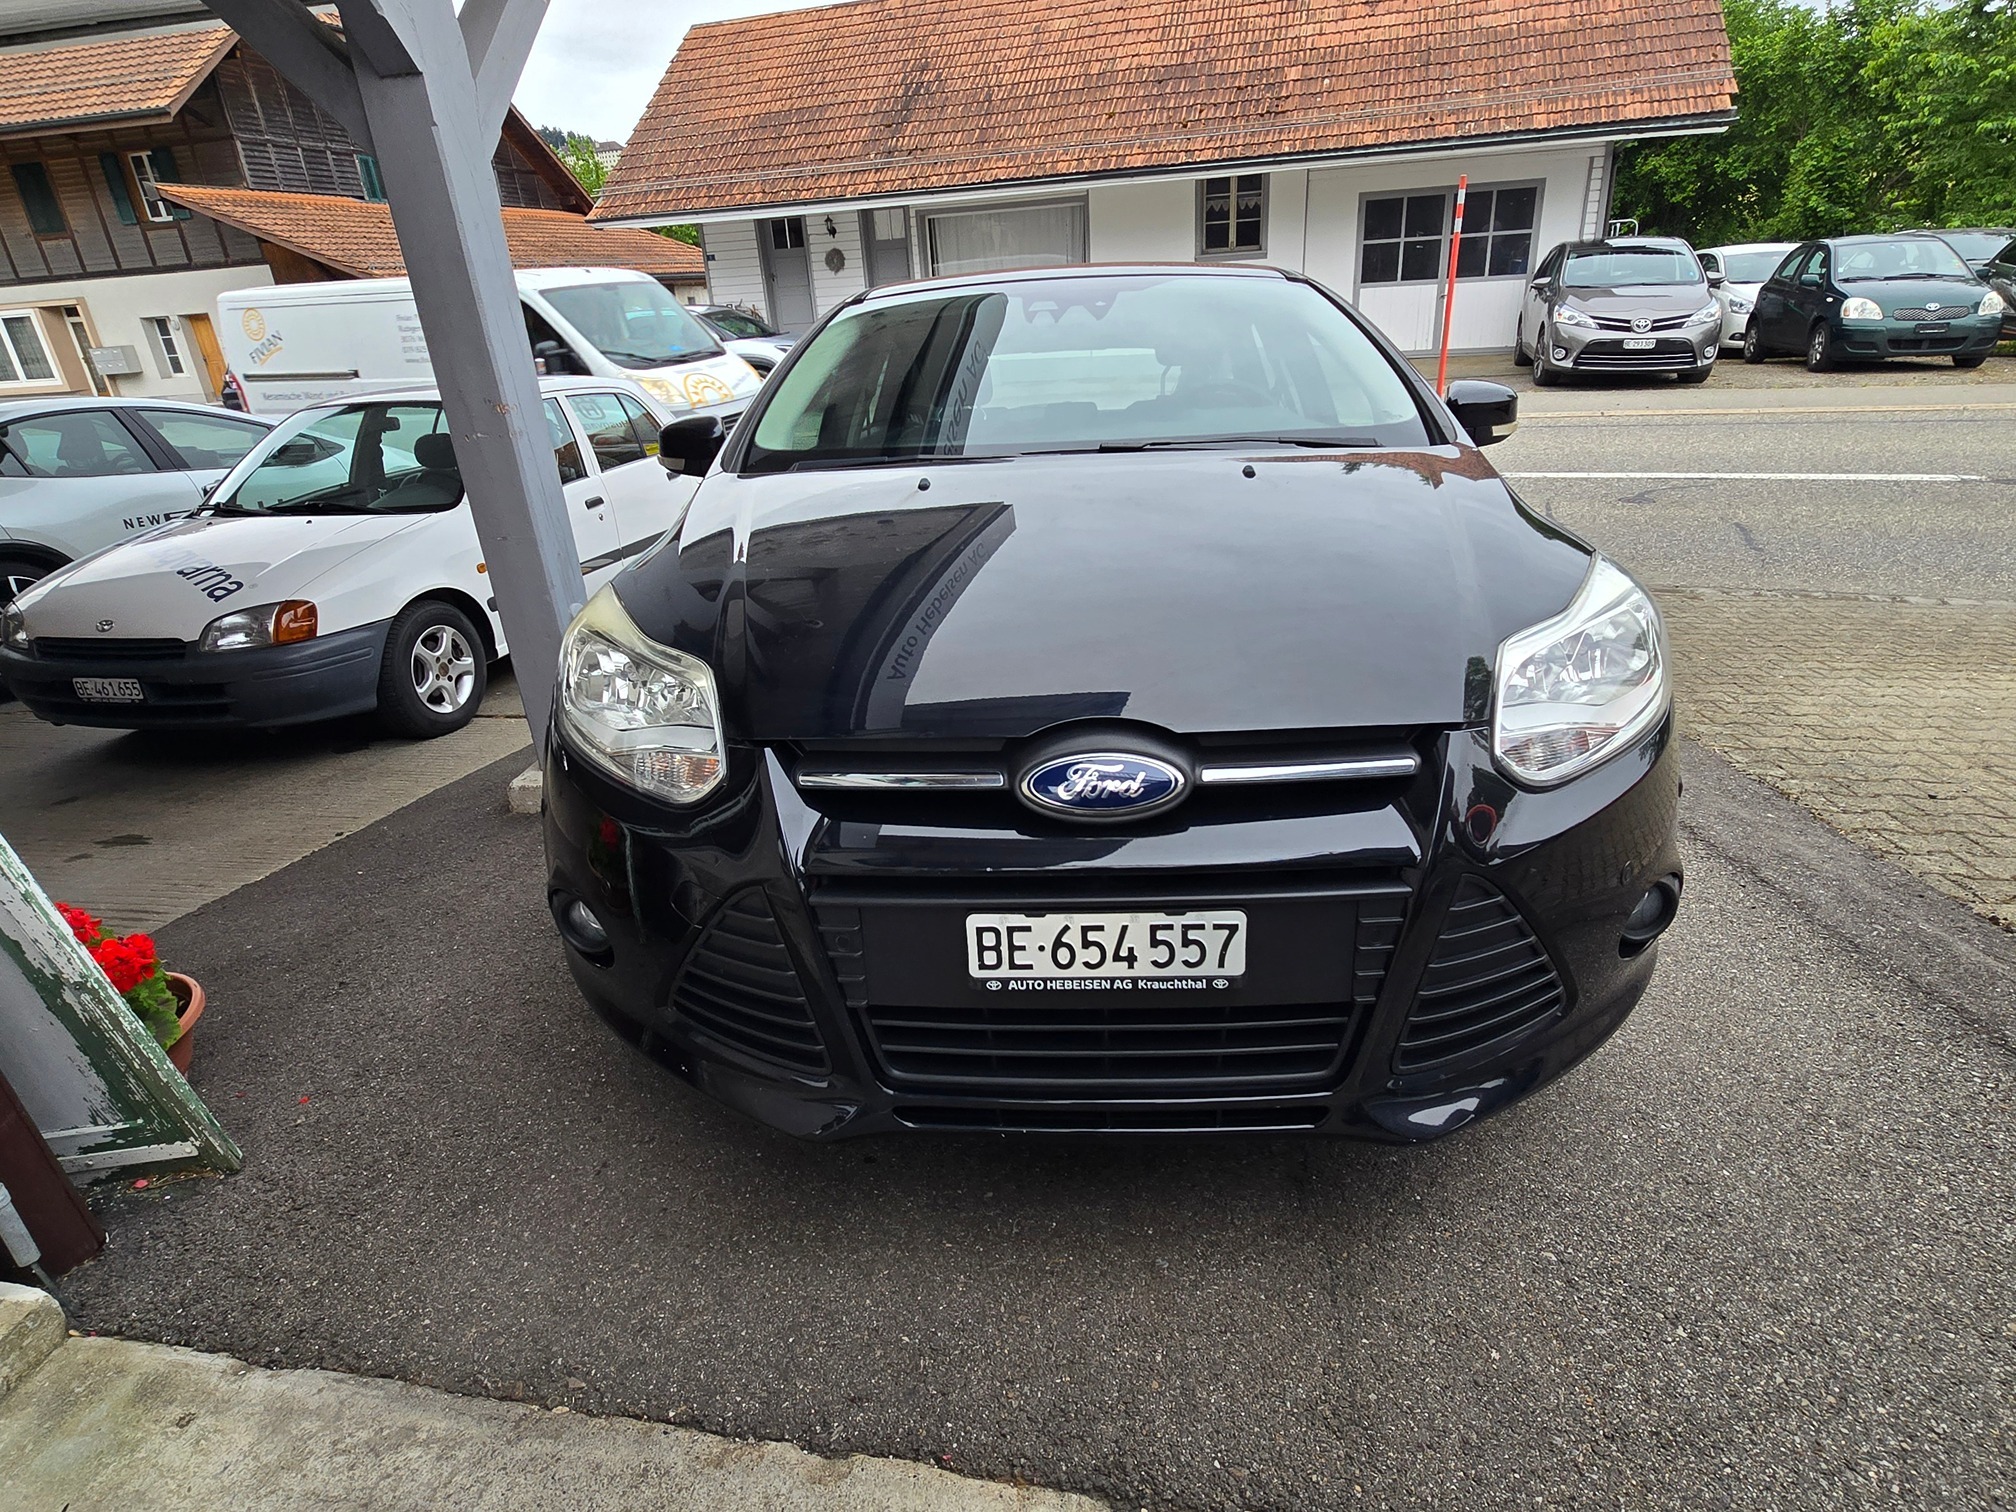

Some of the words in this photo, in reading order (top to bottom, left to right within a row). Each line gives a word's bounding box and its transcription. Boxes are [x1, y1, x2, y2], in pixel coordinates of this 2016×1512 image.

[123, 514, 161, 529] NEW
[1057, 763, 1147, 801] Ford
[1008, 979, 1044, 990] AUTO
[1046, 979, 1111, 990] HEBEISEN
[1113, 979, 1133, 990] AG
[1138, 978, 1207, 990] Krauchthal
